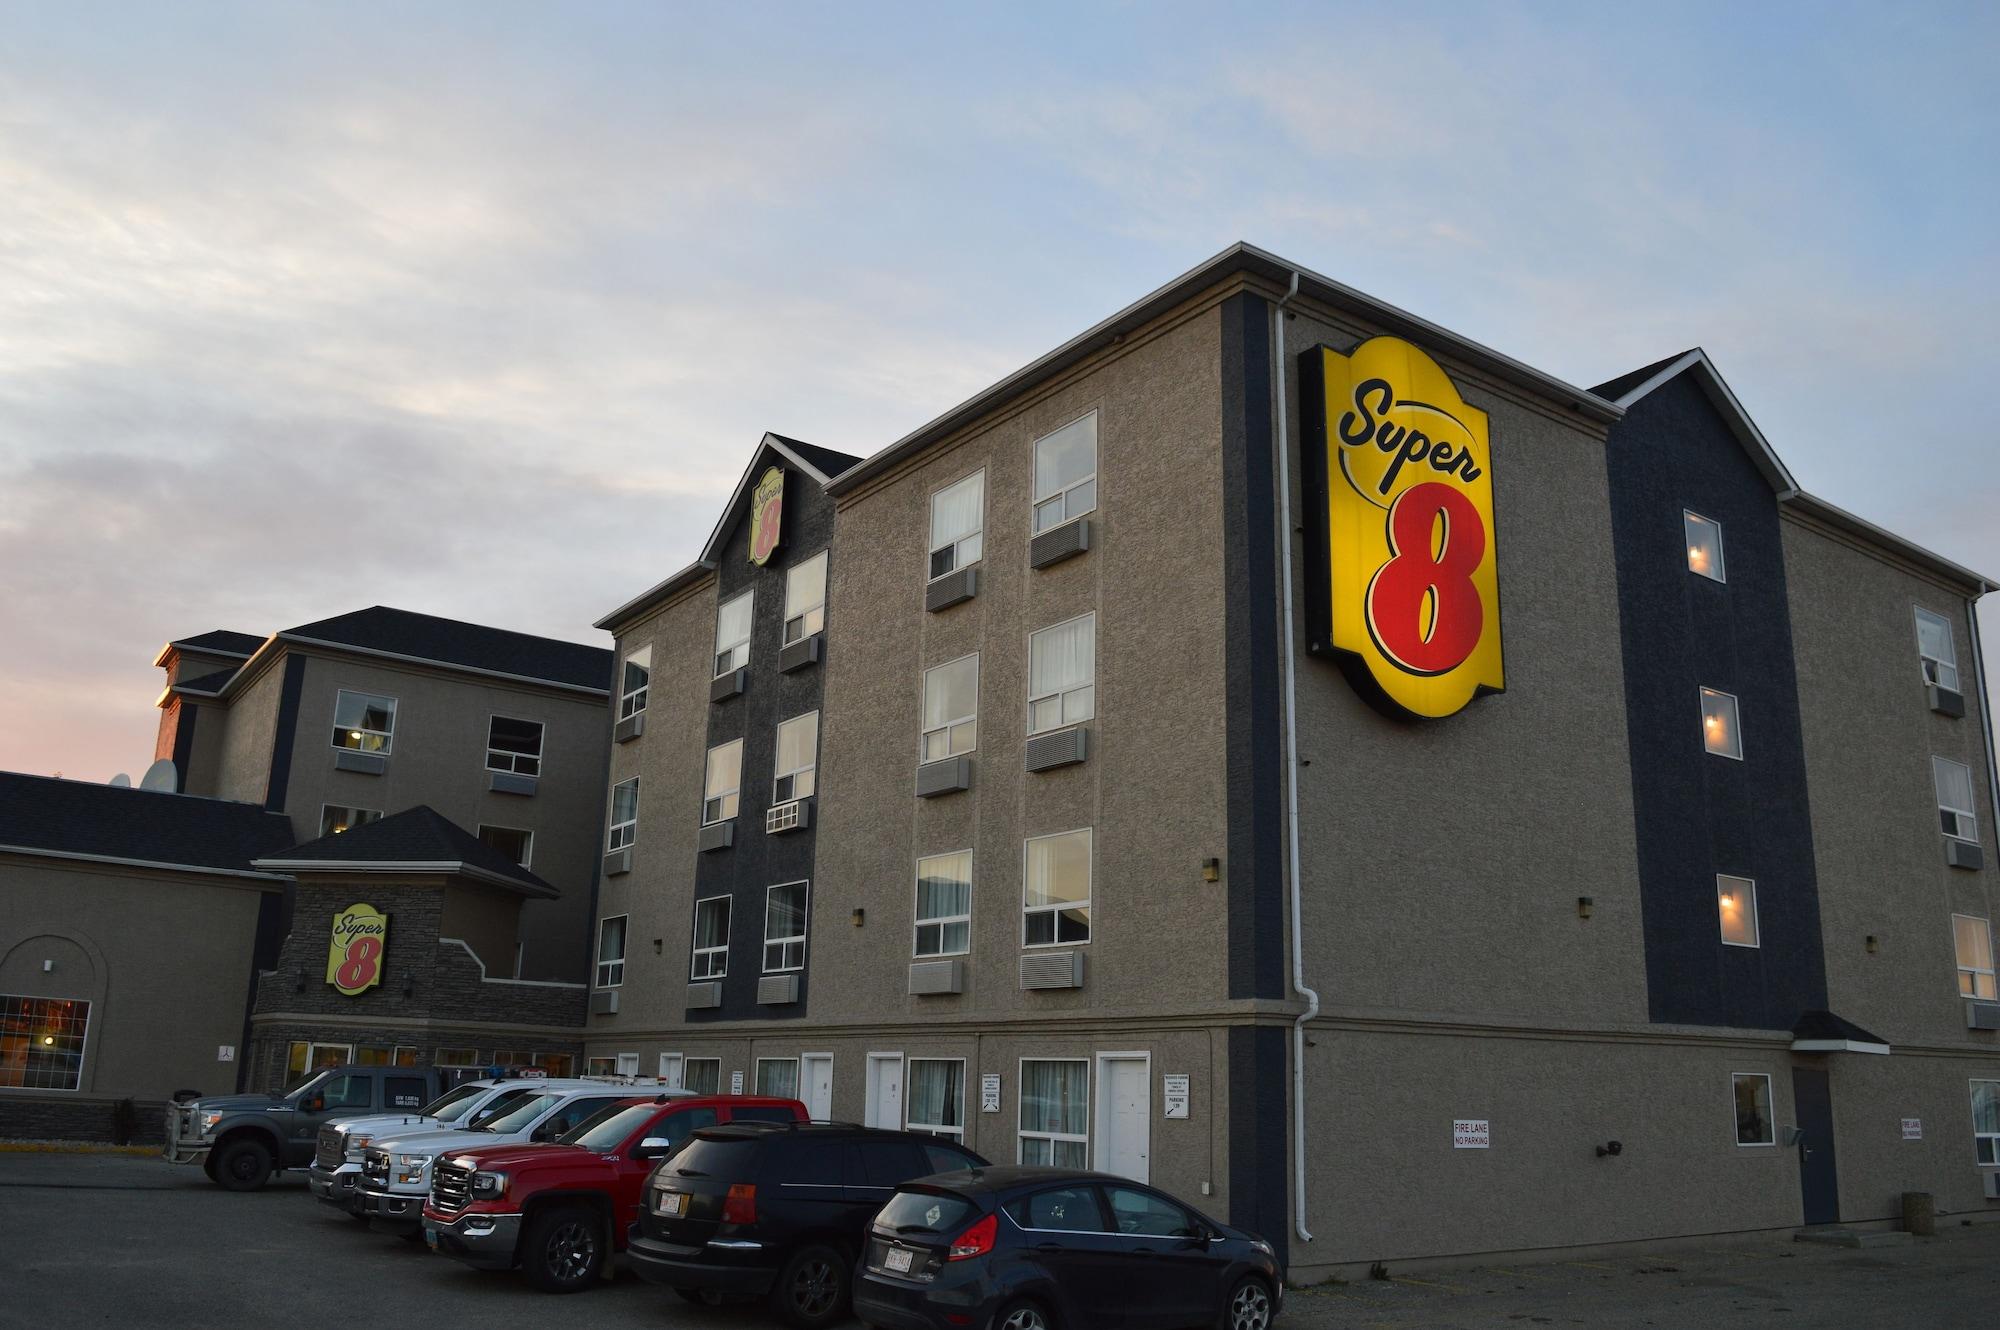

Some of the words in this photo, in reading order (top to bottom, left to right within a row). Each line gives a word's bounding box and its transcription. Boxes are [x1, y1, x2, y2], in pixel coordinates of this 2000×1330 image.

[1339, 378, 1482, 496] Super
[754, 482, 783, 516] Super
[754, 498, 782, 560] 8
[1364, 482, 1485, 677] 8
[334, 913, 384, 945] Super
[335, 936, 382, 990] 8
[1455, 1123, 1470, 1133] FIRE
[1470, 1123, 1488, 1133] LANE
[1455, 1136, 1463, 1145] NO
[1464, 1136, 1488, 1145] PARKING
